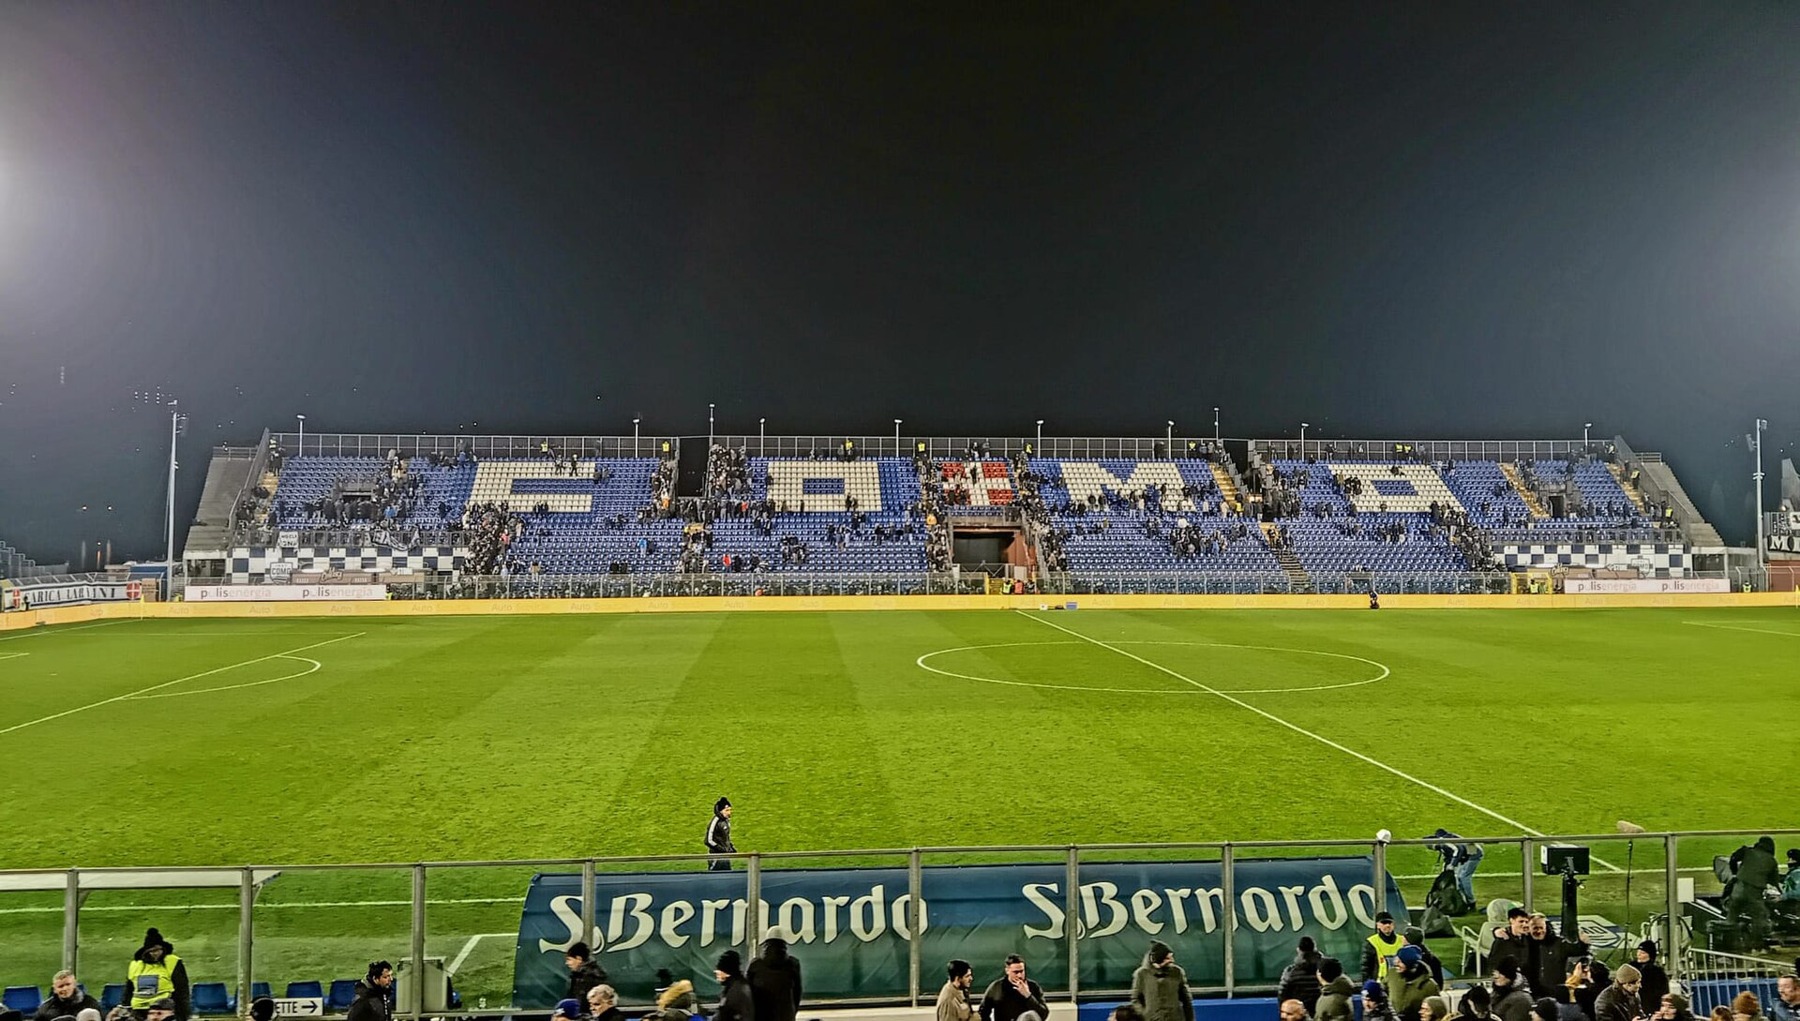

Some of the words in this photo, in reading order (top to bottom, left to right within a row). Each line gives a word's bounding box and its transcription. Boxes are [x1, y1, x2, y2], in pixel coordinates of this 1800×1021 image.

[539, 884, 928, 954] S.Bernardo
[1022, 874, 1376, 940] S.Bernardo
[274, 1001, 298, 1014] ETTE
